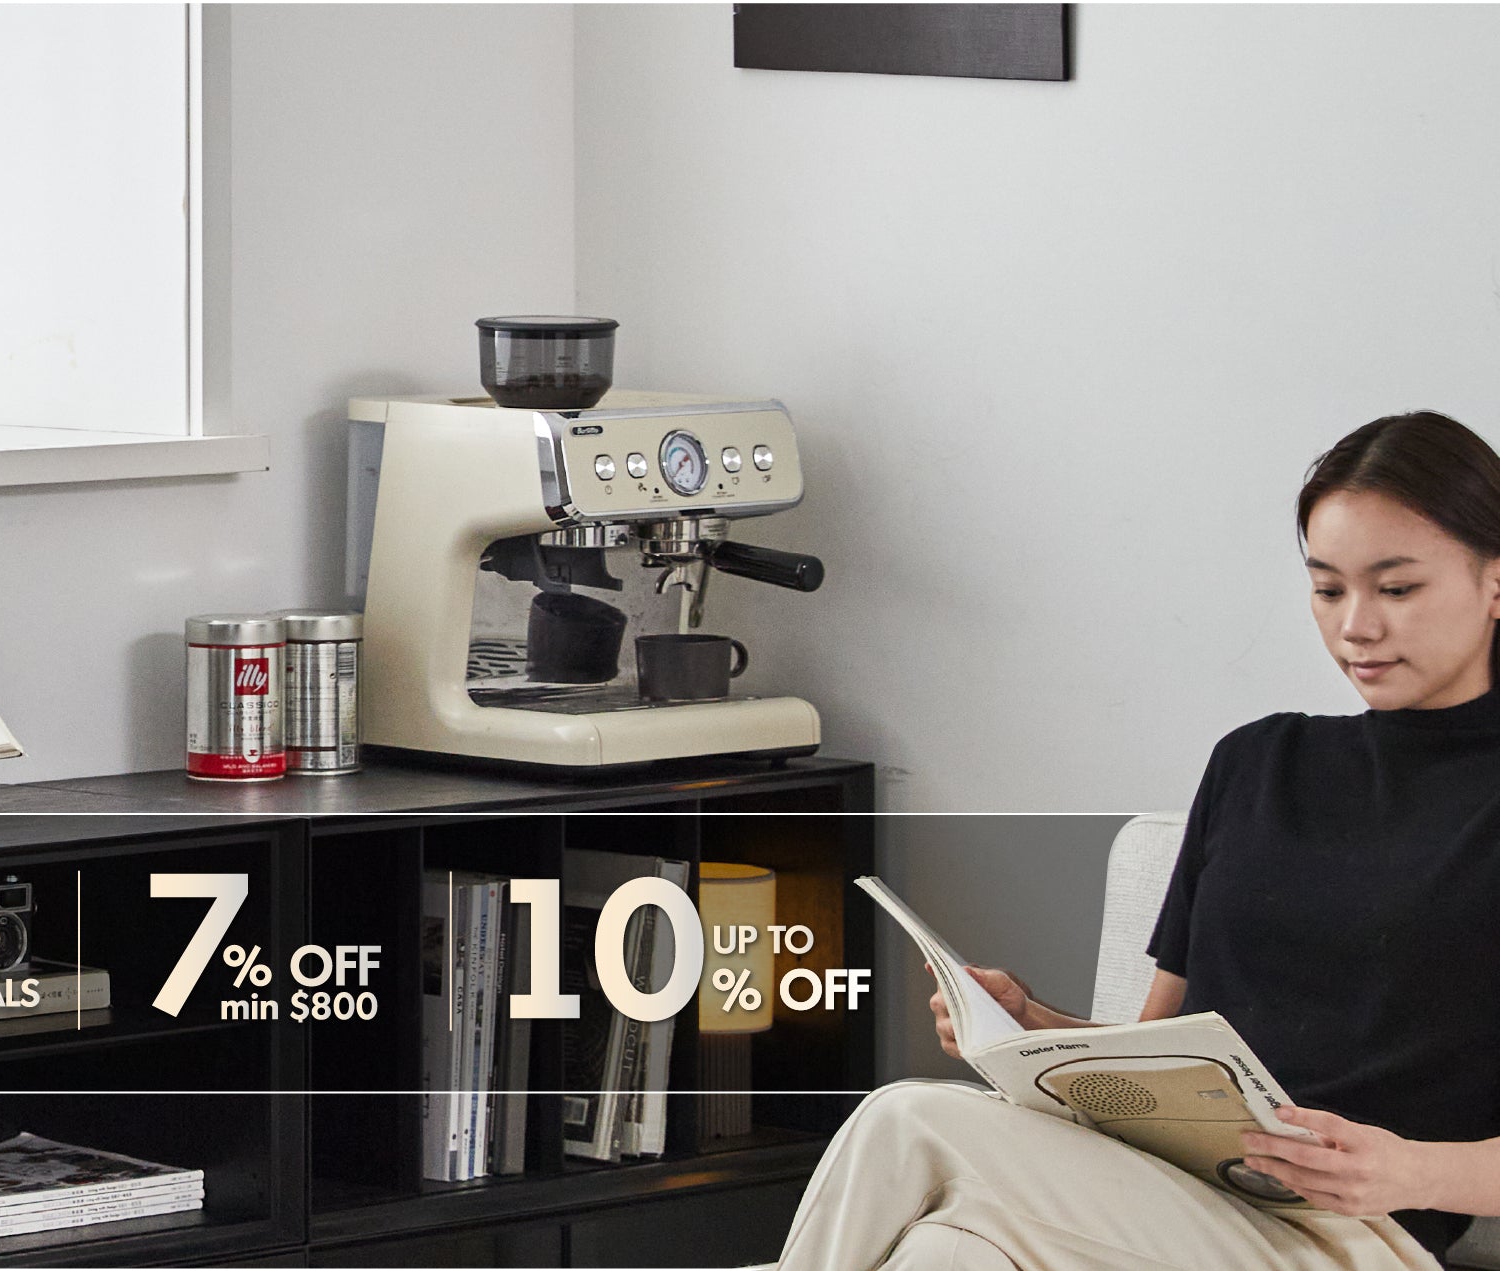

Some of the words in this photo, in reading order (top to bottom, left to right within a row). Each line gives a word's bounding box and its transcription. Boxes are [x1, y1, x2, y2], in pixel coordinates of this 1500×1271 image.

[236, 664, 268, 693] illy
[456, 985, 464, 1015] CASA
[1019, 1045, 1054, 1058] Dieter
[1055, 1041, 1090, 1051] Rams
[1229, 1053, 1254, 1077] besser
